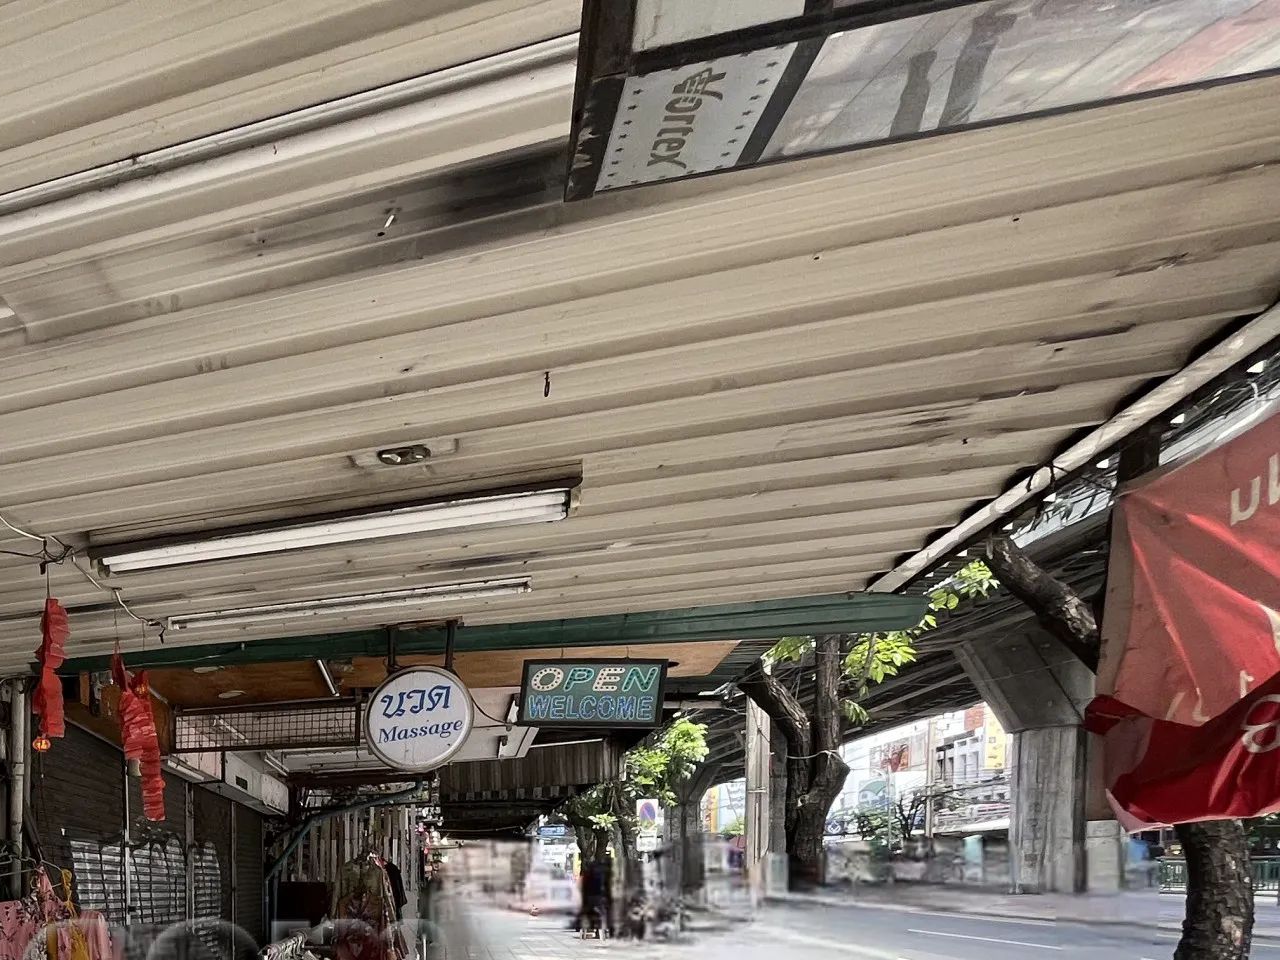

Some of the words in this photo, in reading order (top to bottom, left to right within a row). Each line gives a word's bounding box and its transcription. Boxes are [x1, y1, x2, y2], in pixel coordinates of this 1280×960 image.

[530, 666, 660, 692] OPEN
[379, 683, 452, 720] นวด
[528, 694, 655, 720] WELCOME
[378, 718, 464, 744] Massage
